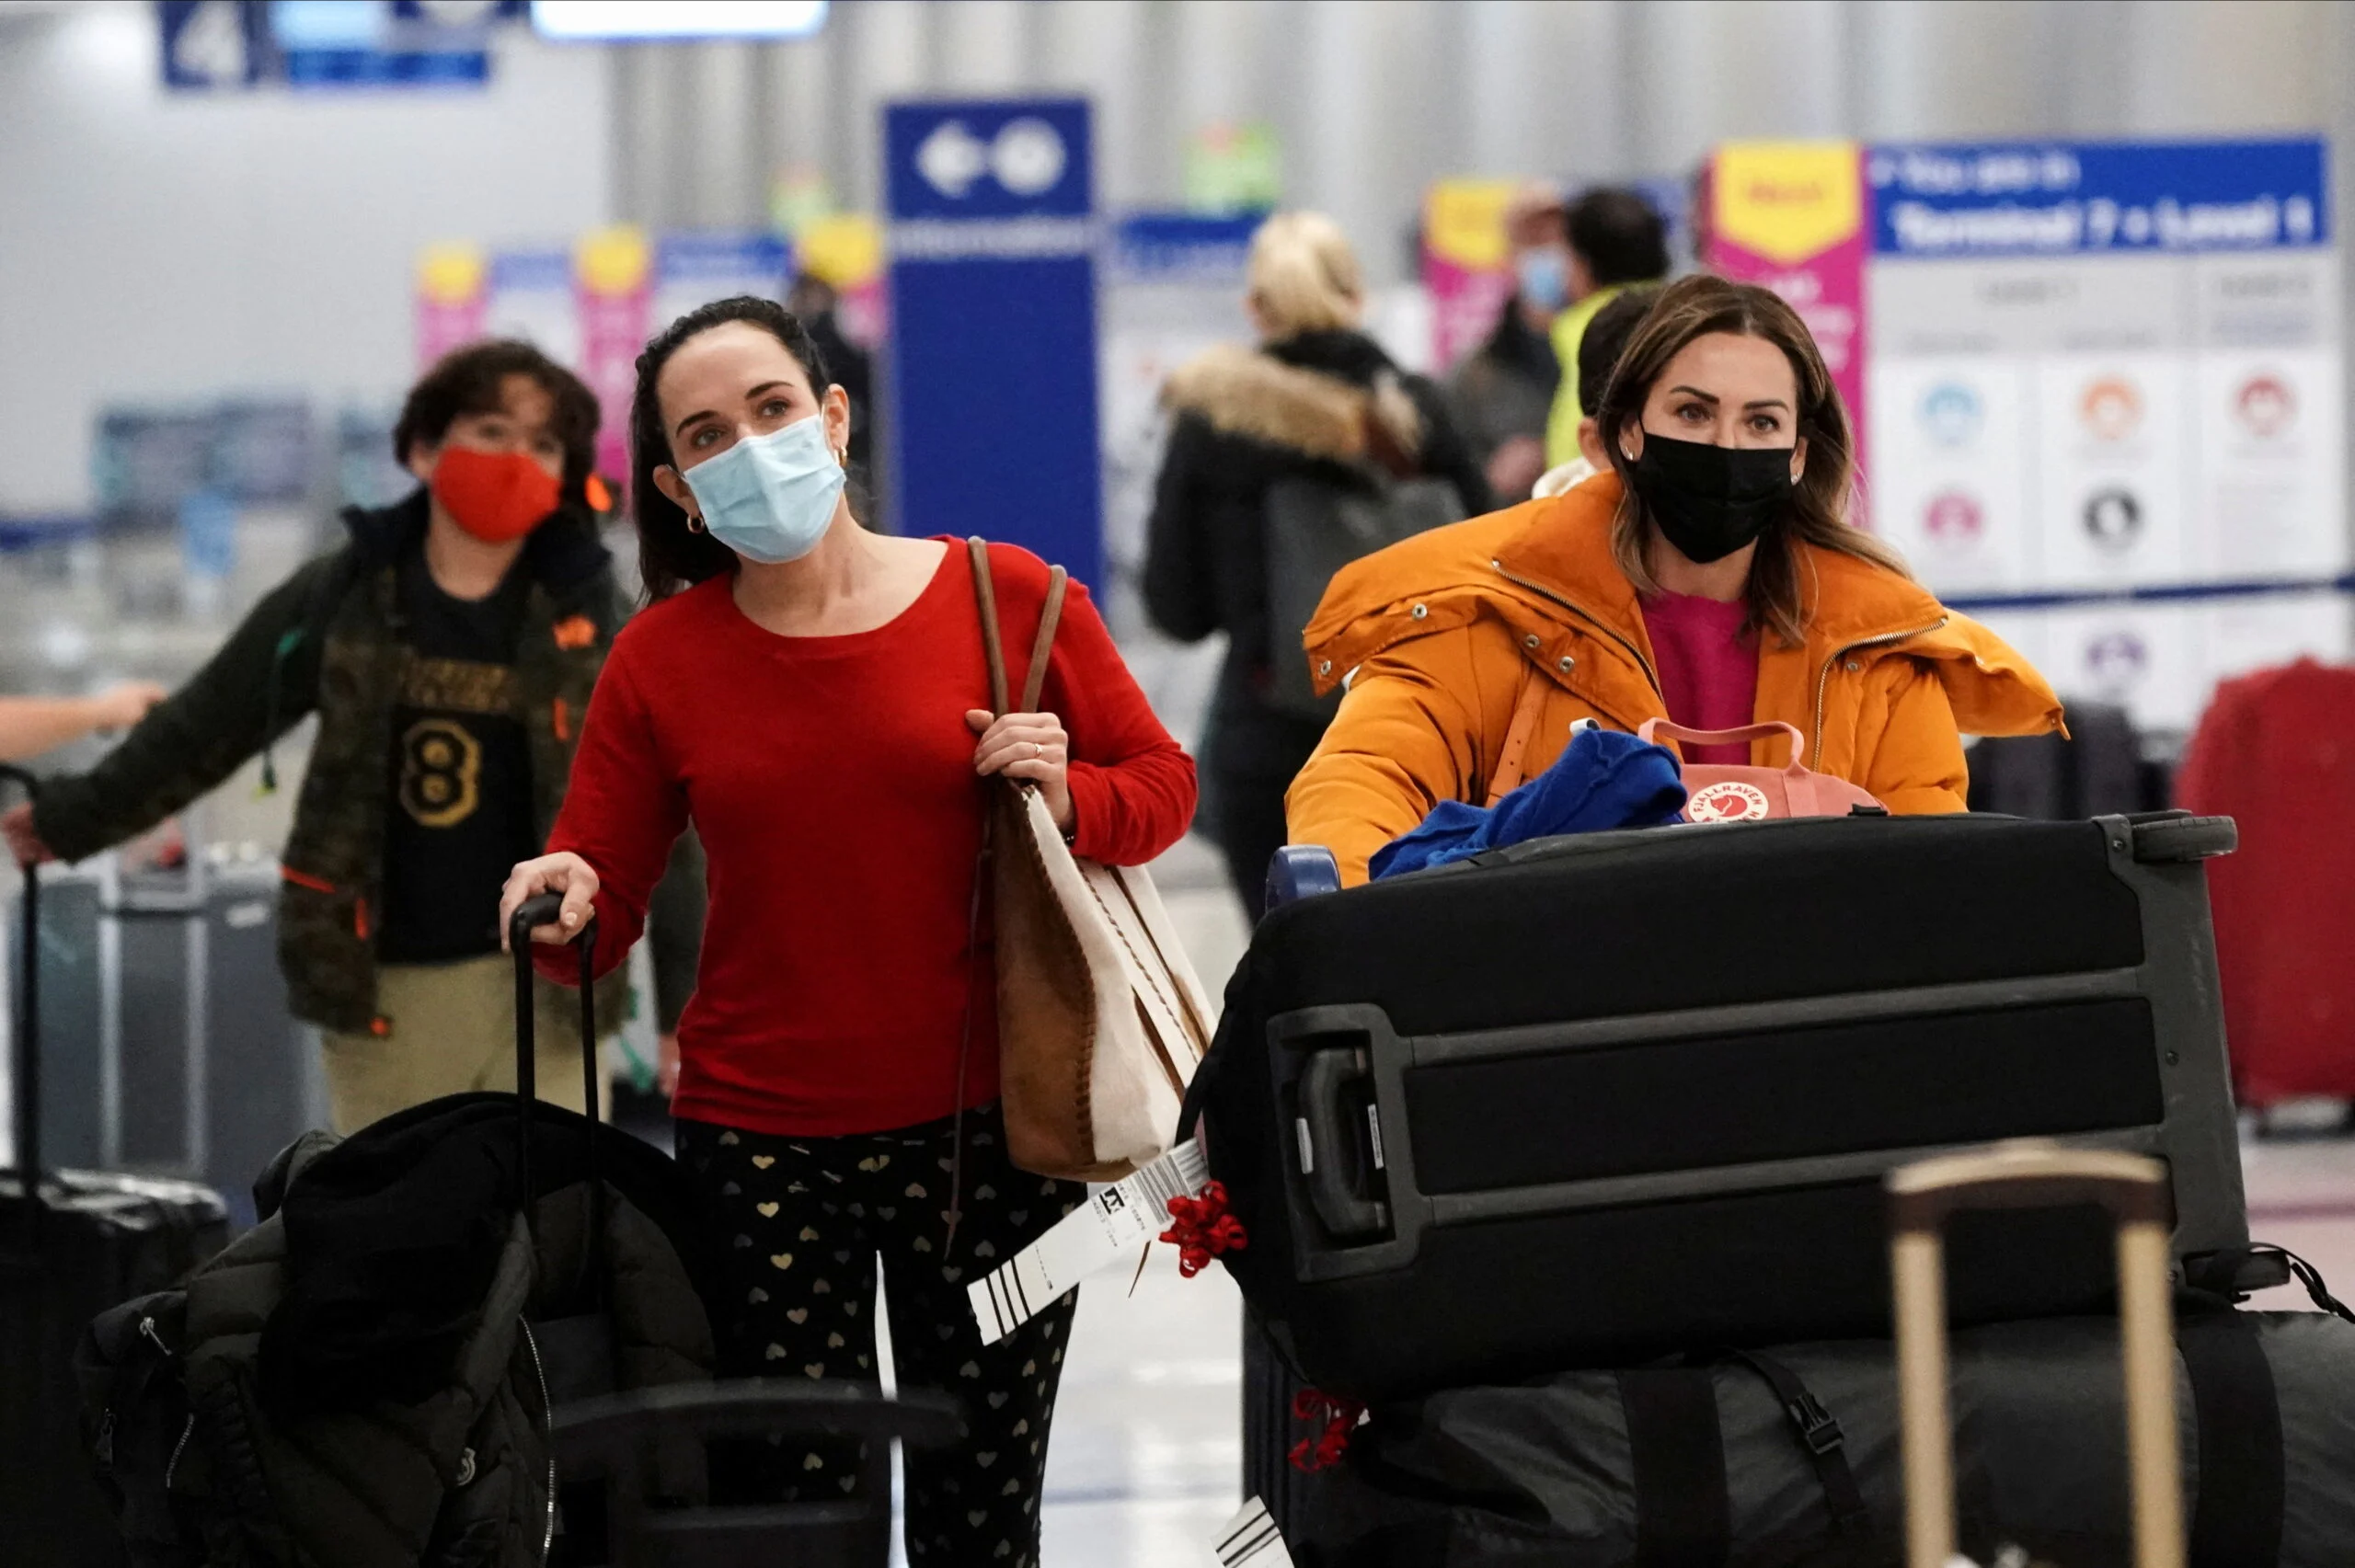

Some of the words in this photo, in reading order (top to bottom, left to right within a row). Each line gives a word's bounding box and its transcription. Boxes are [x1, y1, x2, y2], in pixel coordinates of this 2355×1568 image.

[1893, 197, 2083, 250] Terminal
[2154, 194, 2279, 246] Level
[399, 717, 480, 828] 8
